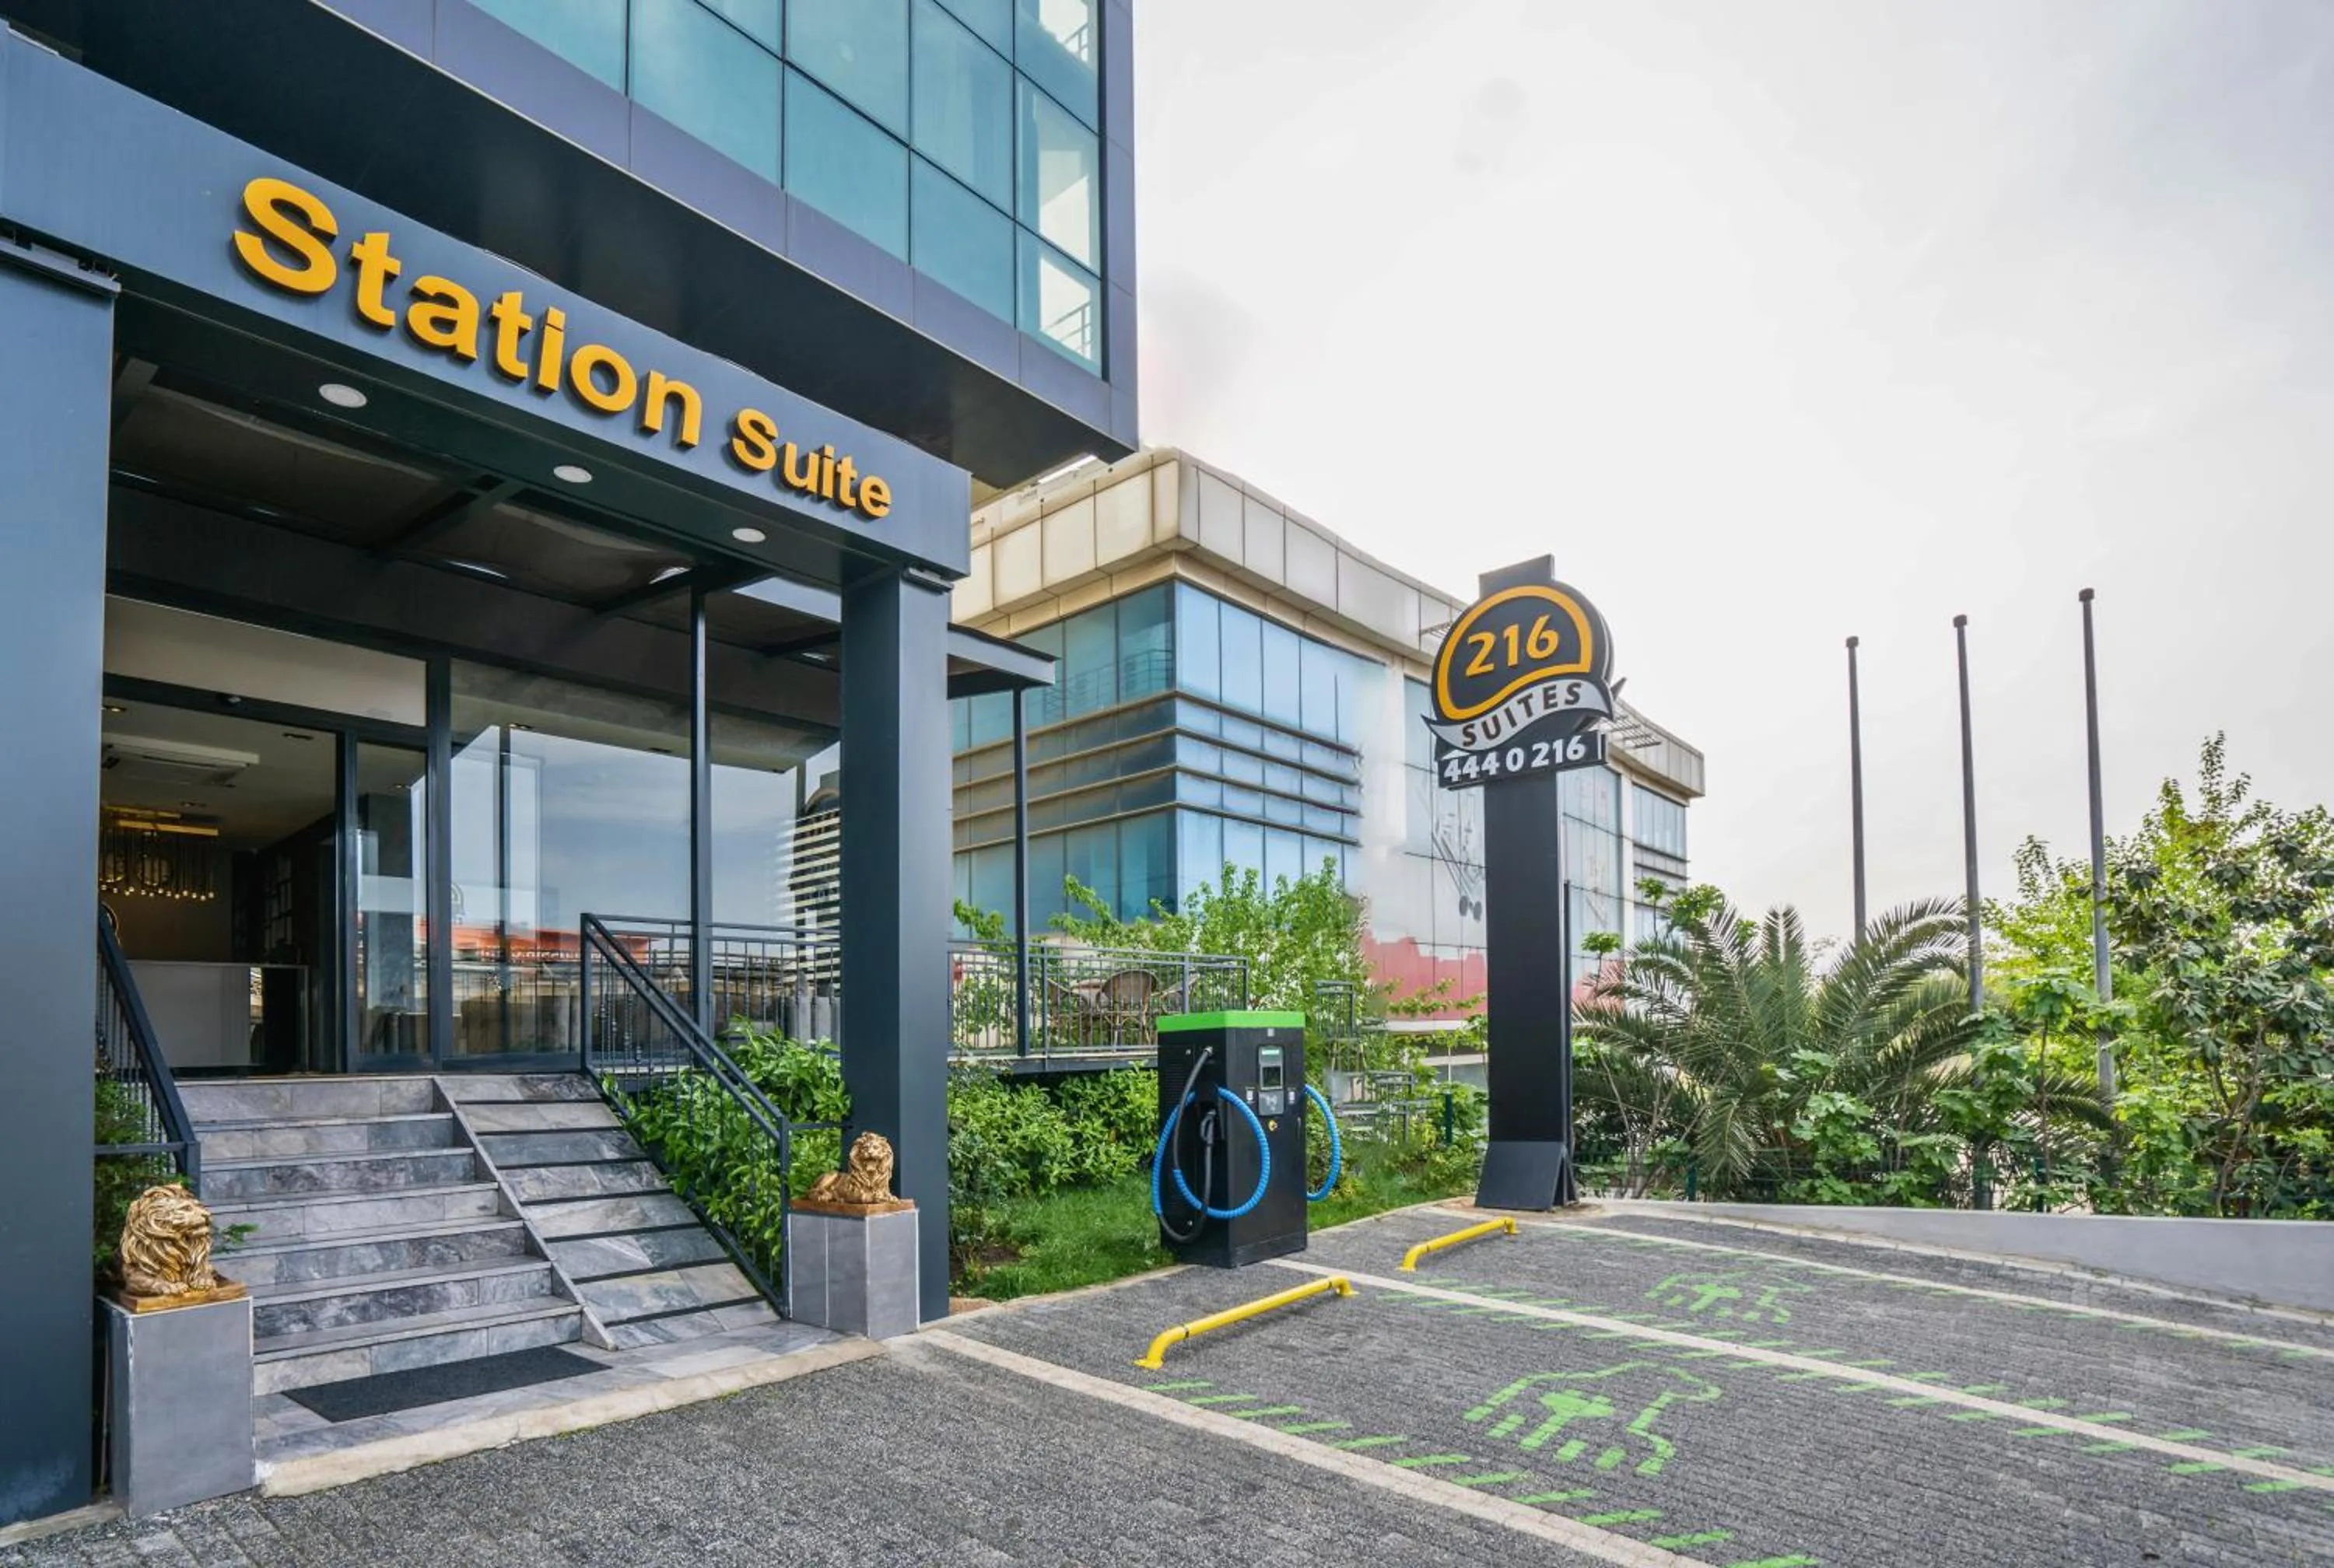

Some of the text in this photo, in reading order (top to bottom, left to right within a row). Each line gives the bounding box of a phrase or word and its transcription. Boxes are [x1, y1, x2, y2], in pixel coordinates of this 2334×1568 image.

[233, 177, 892, 519] Station Suite
[1466, 614, 1559, 677] 216
[1462, 682, 1582, 747] SUITES
[1443, 751, 1500, 782] 444
[1530, 735, 1586, 768] 216
